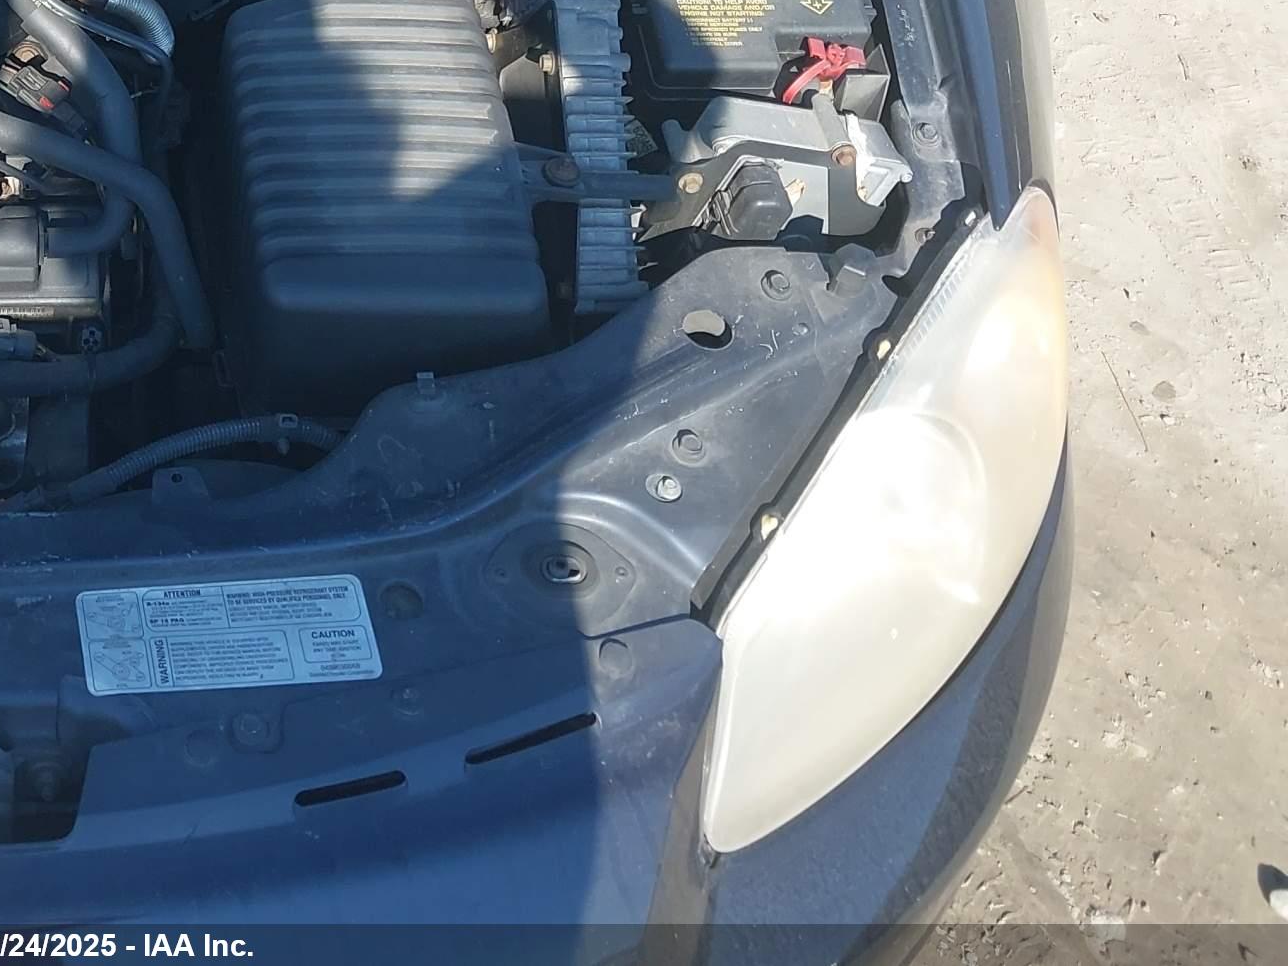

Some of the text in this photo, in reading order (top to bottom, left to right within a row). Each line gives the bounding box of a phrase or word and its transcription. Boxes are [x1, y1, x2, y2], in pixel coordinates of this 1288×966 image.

[164, 589, 201, 598] ATTENTION
[312, 629, 355, 639] CAUTION
[154, 639, 170, 684] WARNING
